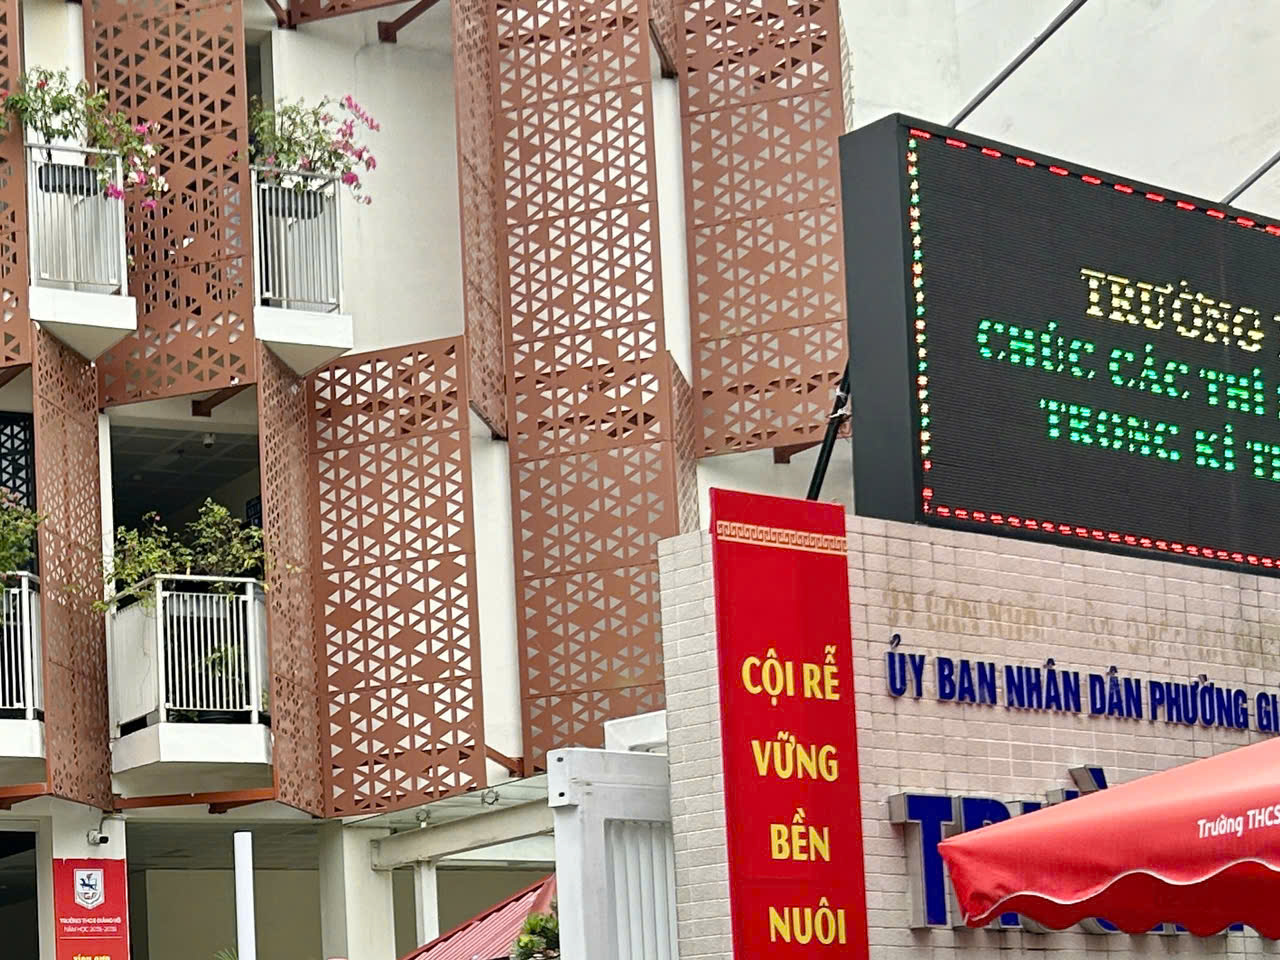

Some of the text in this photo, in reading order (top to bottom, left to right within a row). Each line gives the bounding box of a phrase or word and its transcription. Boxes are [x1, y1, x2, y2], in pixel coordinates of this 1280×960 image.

[977, 319, 1096, 379] CHÚC
[1108, 342, 1190, 400] CÁC
[1039, 397, 1181, 462] TRONG
[742, 644, 840, 706] CỘI RỄ
[935, 657, 997, 705] BAN
[1004, 658, 1081, 712] NHÂN
[1089, 666, 1143, 720] DÂN
[1148, 674, 1248, 730] PHƯỜNG
[751, 732, 839, 782] VỮNG
[770, 808, 830, 862] BỀN
[1197, 804, 1280, 838] Trường THCS
[768, 897, 847, 945] NUÔI
